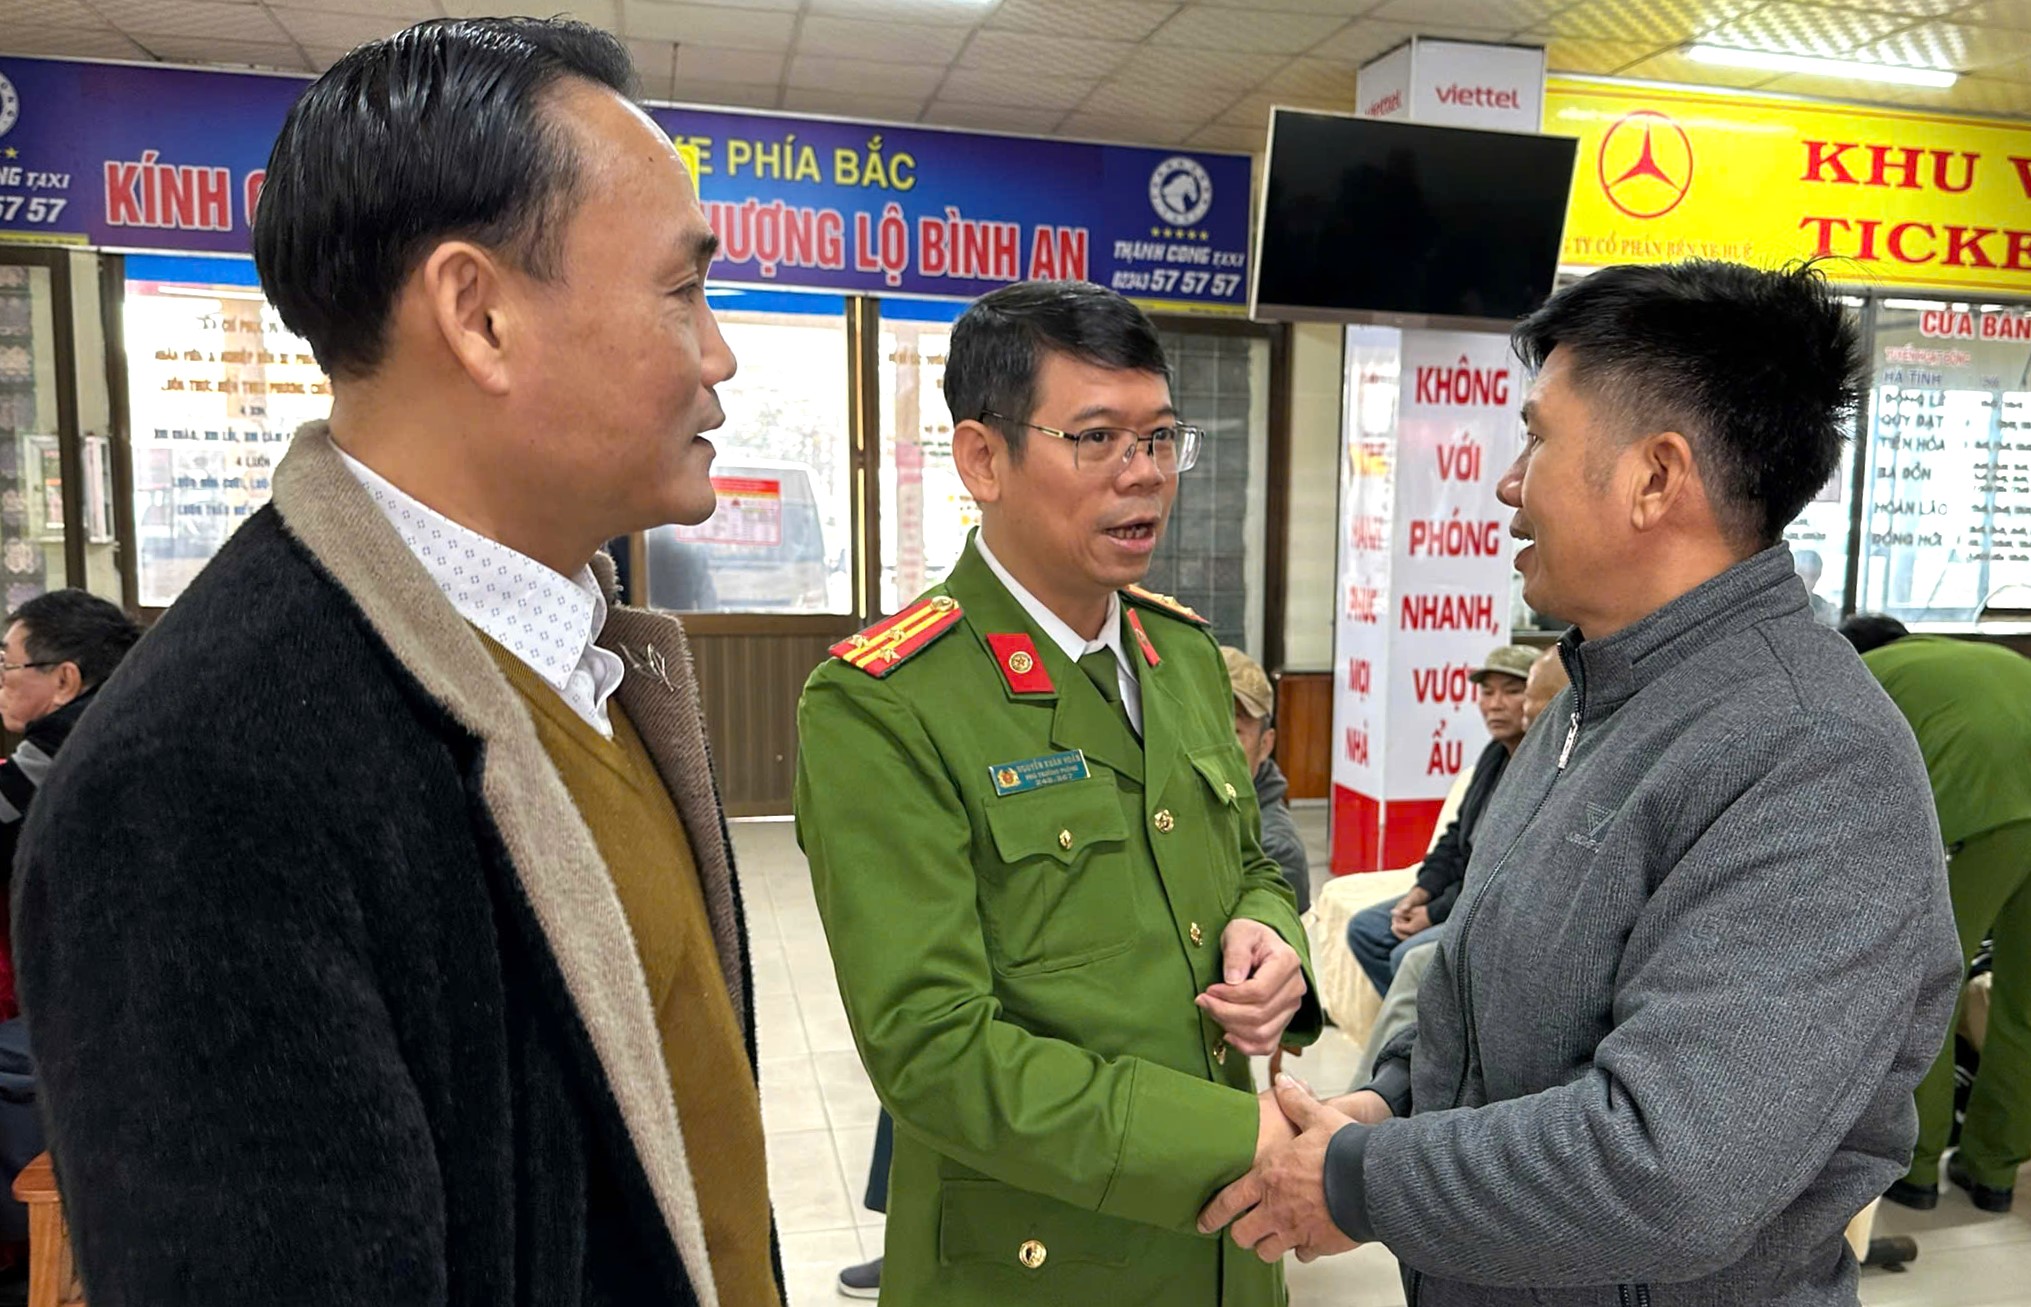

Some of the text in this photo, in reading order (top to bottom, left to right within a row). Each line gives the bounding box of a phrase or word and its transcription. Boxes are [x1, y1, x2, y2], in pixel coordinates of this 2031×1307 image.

[1435, 82, 1520, 110] viettel
[26, 171, 71, 191] TAXI
[727, 134, 822, 183] PHÍA
[834, 135, 916, 190] BẮC
[1800, 140, 1981, 193] KHU
[26, 197, 68, 223] 57
[104, 150, 233, 231] KÍNH
[855, 201, 908, 286] LỘ
[919, 206, 1021, 281] BÌNH
[1028, 225, 1089, 281] AN
[1799, 216, 2031, 271] TICKE
[1150, 267, 1180, 292] 57
[1180, 270, 1211, 294] 57
[1210, 273, 1241, 297] 57
[1414, 354, 1510, 405] KHÔNG
[1436, 432, 1481, 482] VỚI
[1408, 507, 1500, 556] PHÓNG
[1400, 592, 1500, 636] NHANH,
[1412, 662, 1480, 711] VƯỢT
[1426, 719, 1463, 776] ẨU
